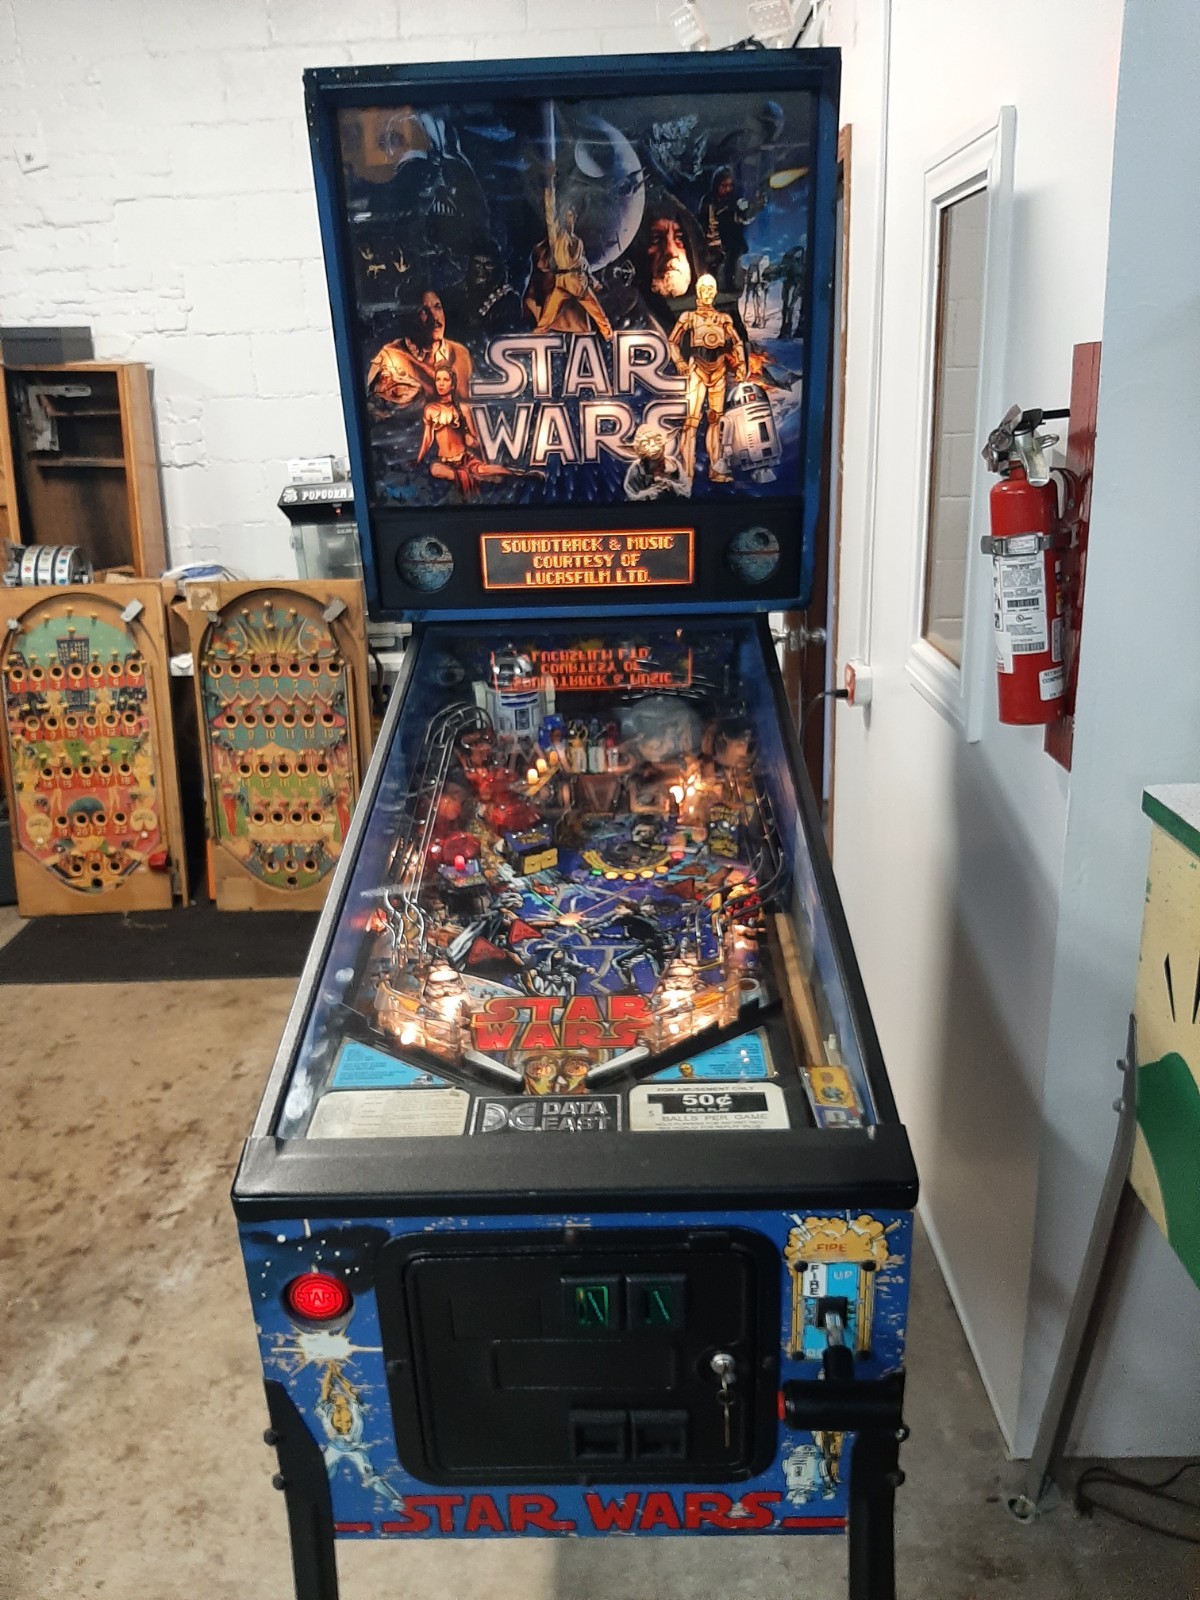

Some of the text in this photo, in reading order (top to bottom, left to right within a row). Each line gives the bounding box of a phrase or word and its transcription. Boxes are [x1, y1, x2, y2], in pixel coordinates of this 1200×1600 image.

[469, 331, 689, 398] STAR
[472, 399, 690, 466] WARS
[501, 536, 675, 554] SOUNDTRACK & MUSIC
[533, 553, 641, 569] COURTESY OF
[526, 569, 651, 585] LUCASFILM LTD.
[74, 680, 80, 688] 4
[106, 727, 116, 735] 12
[125, 726, 136, 734] 13
[265, 729, 276, 738] 10
[285, 729, 295, 738] 11
[304, 729, 315, 738] 12
[472, 995, 653, 1023] STAR
[472, 1021, 653, 1050] WARS
[543, 1101, 608, 1115] DATA
[682, 1094, 733, 1107] 50¢
[541, 1116, 611, 1132] EAST
[816, 1243, 847, 1253] FIRE
[809, 1264, 820, 1295] FIRE
[833, 1271, 853, 1280] UP
[297, 1291, 339, 1304] START
[382, 1491, 783, 1533] STAR WARS
